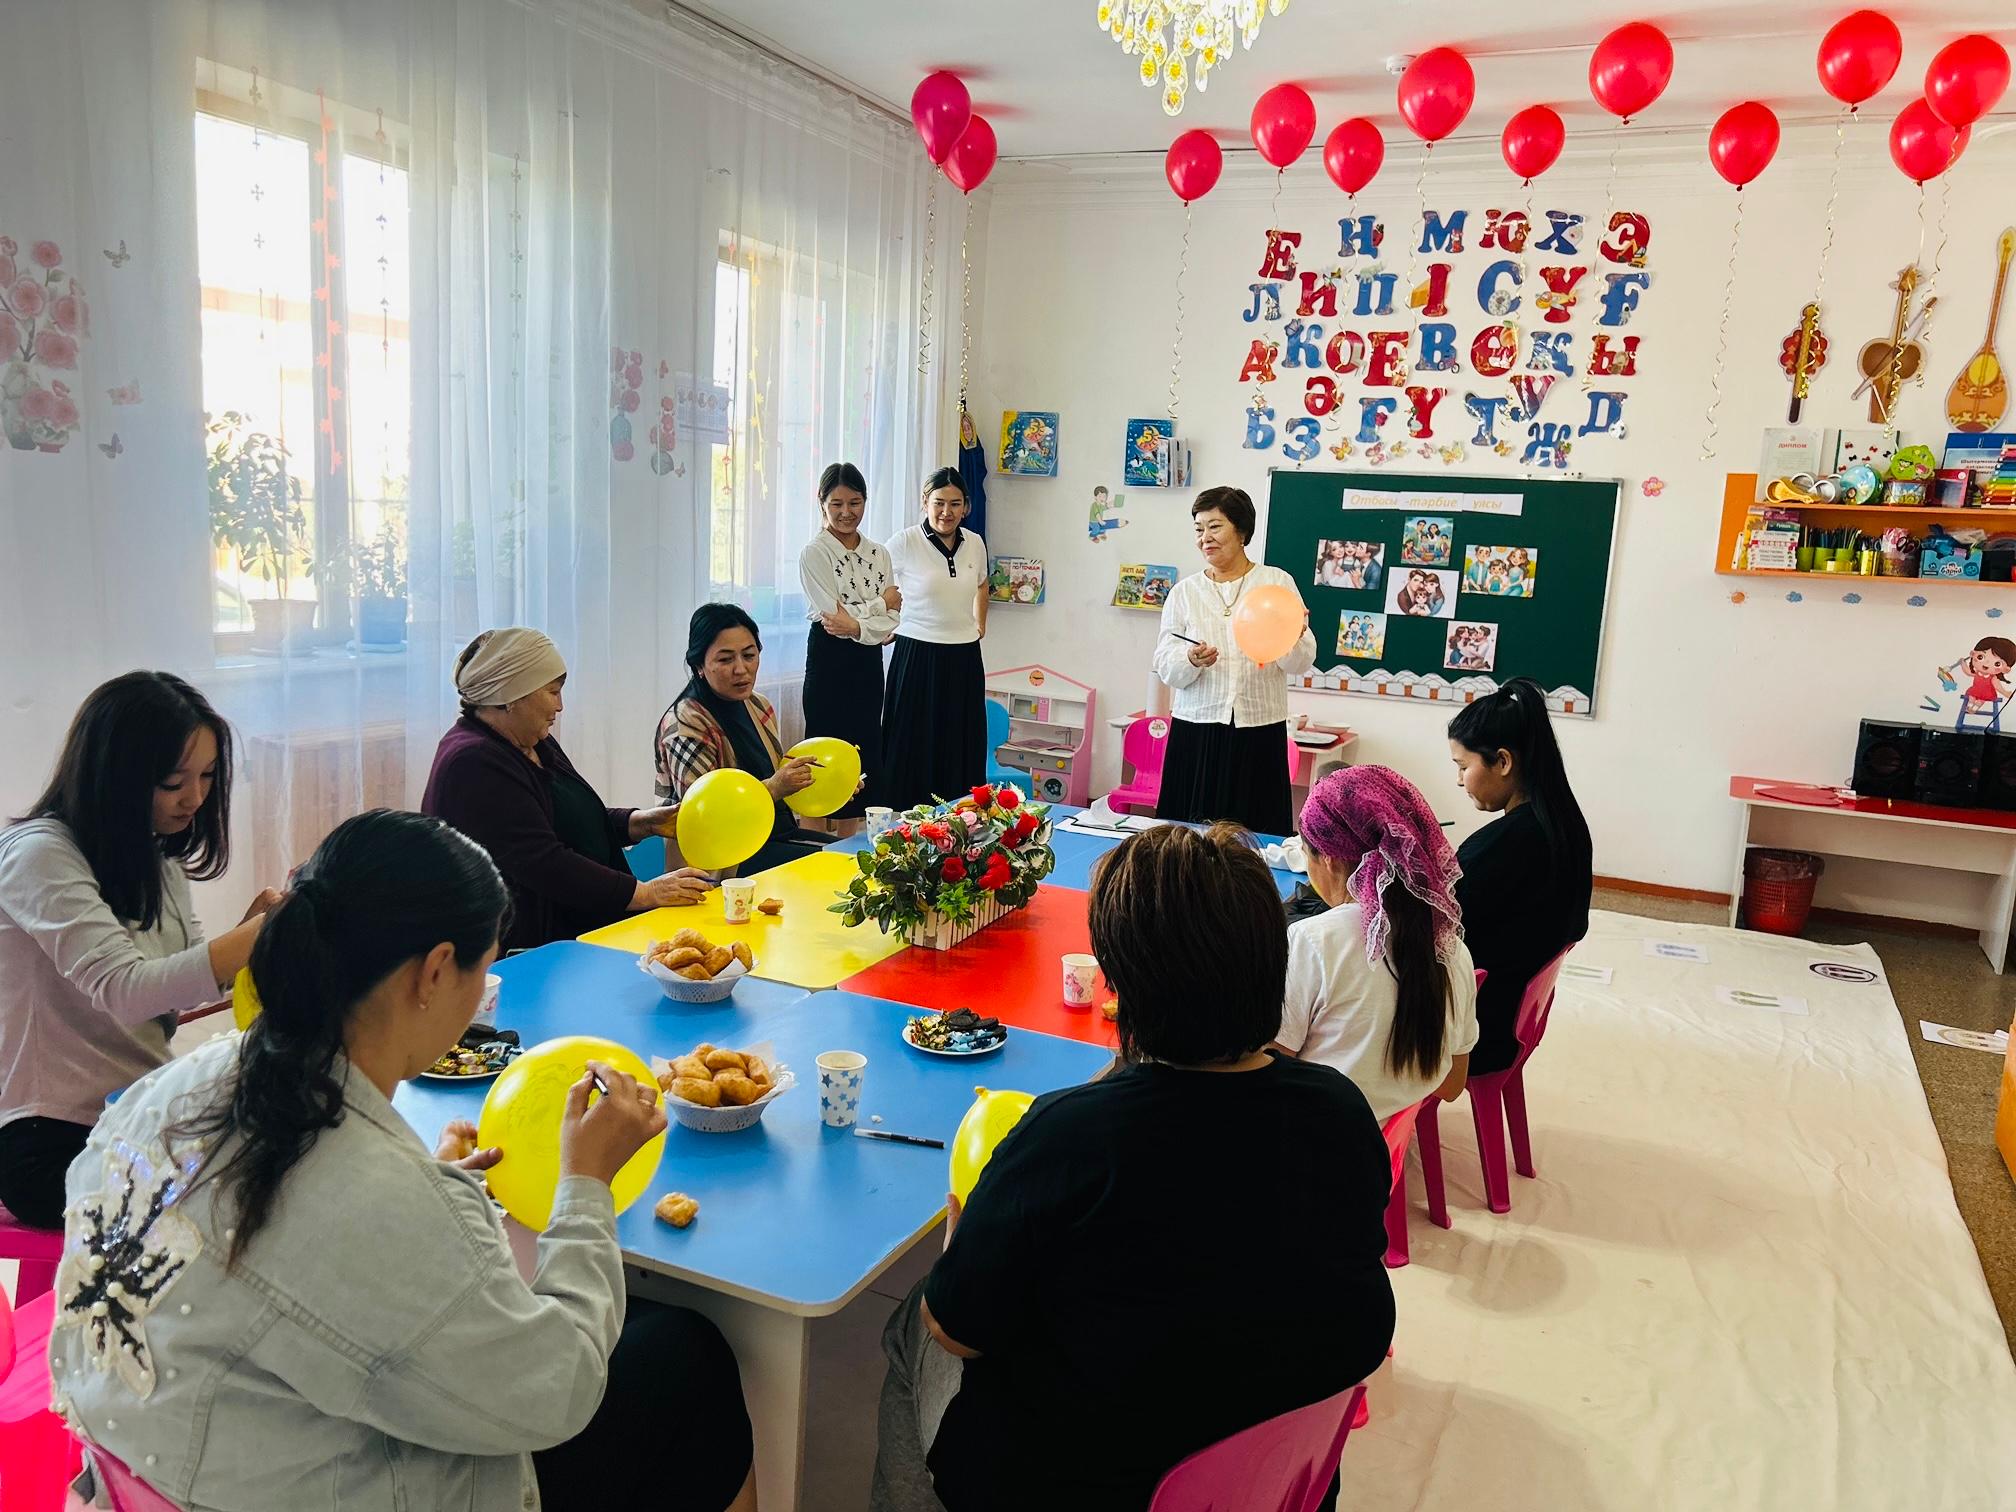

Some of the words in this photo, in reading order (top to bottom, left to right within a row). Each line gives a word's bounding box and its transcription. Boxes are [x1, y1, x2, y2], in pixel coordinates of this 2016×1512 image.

[1417, 210, 1469, 254] М
[1479, 209, 1529, 254] Ю
[1534, 210, 1584, 255] Х
[1600, 211, 1650, 264] Э
[1242, 283, 1282, 323] Л
[1352, 272, 1399, 316] П
[1477, 260, 1523, 317] С
[1238, 339, 1279, 382] А
[1281, 320, 1324, 369] К
[1325, 330, 1367, 374] О
[1414, 323, 1459, 373] В
[1587, 335, 1641, 376] Ы
[1242, 407, 1276, 450] Б
[1519, 421, 1572, 469] Ж
[1304, 375, 1341, 417] Ә
[1465, 395, 1509, 446] Т
[1577, 391, 1629, 440] Д
